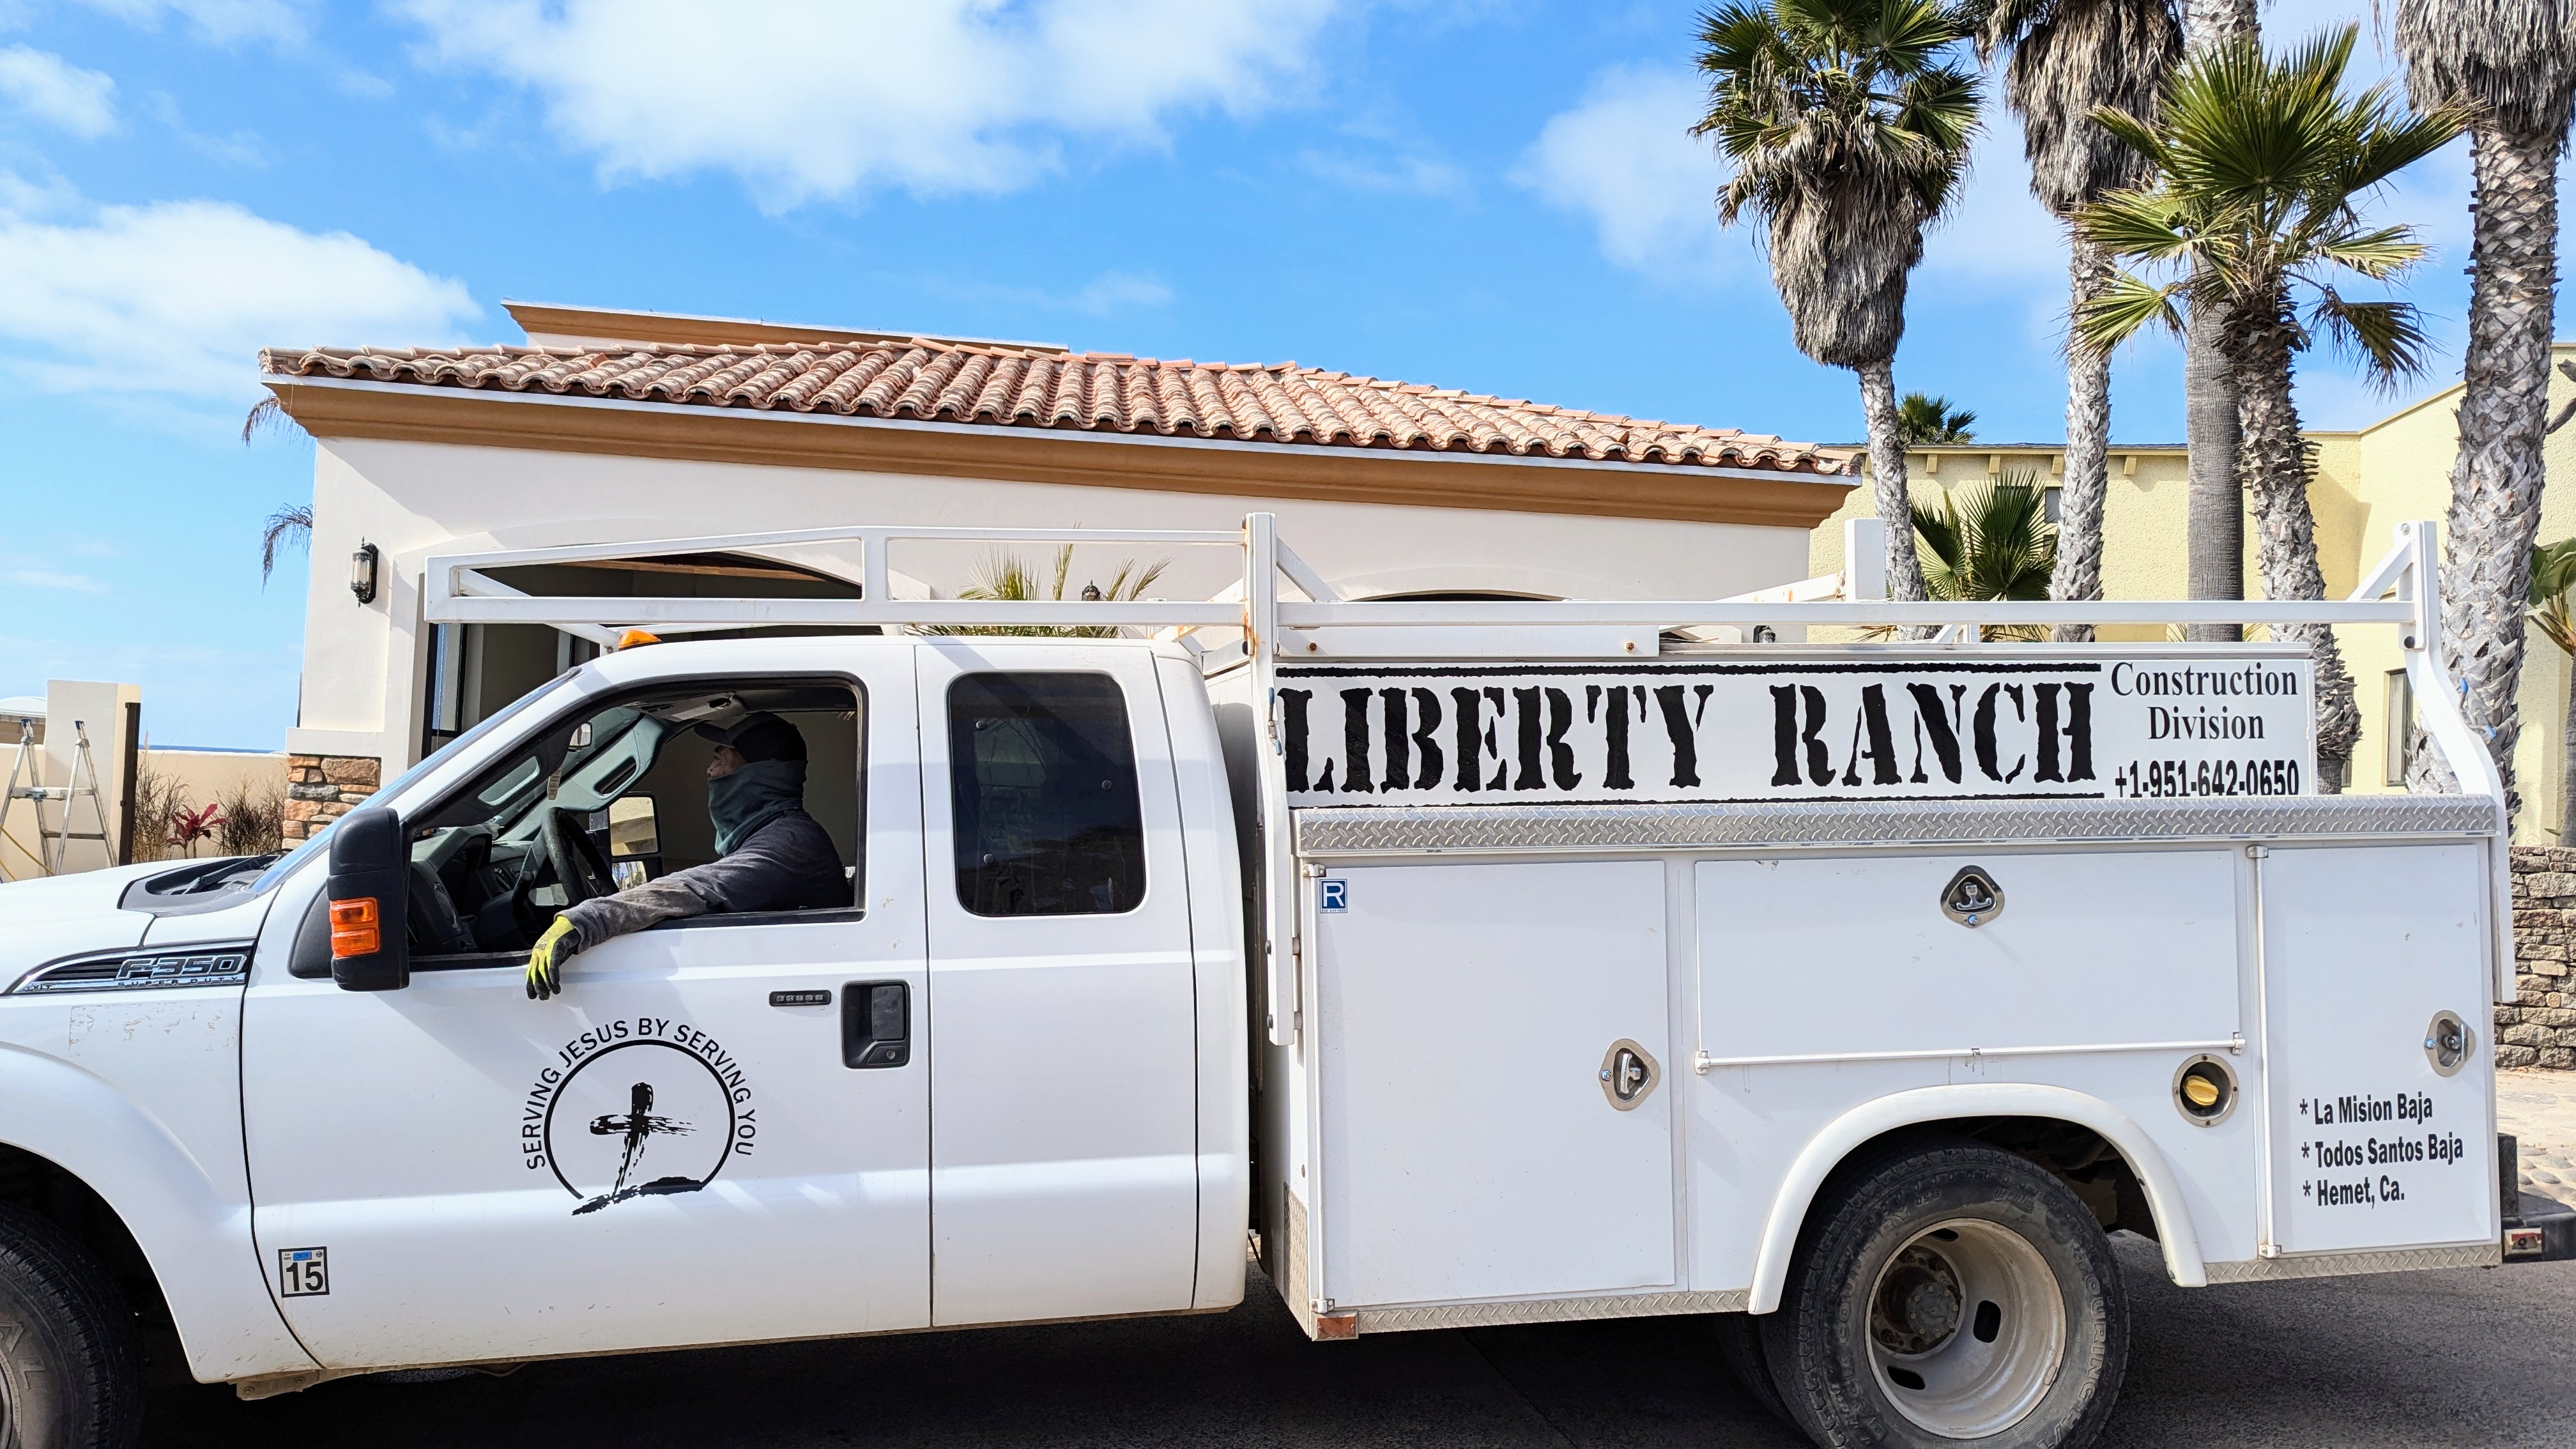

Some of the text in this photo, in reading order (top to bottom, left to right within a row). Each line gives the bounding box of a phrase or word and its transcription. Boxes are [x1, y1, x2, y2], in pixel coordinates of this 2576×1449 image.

[2111, 662, 2298, 696] Construction
[1277, 681, 2097, 794] LIBERTY RANCH
[2148, 705, 2265, 740] Division
[2115, 759, 2299, 798] +1-951-642-0650
[1323, 882, 1344, 907] R
[118, 976, 238, 988] SUPER DUTY
[522, 1018, 756, 1170] SERVING JESUS BY SERVING YOU
[2314, 1091, 2433, 1125] La Mision Baja
[2315, 1131, 2464, 1168] Todos Santos Baja
[2317, 1175, 2405, 1209] Hemet, Ca.
[286, 1261, 324, 1292] 15
[2077, 1252, 2107, 1402] TOURING
